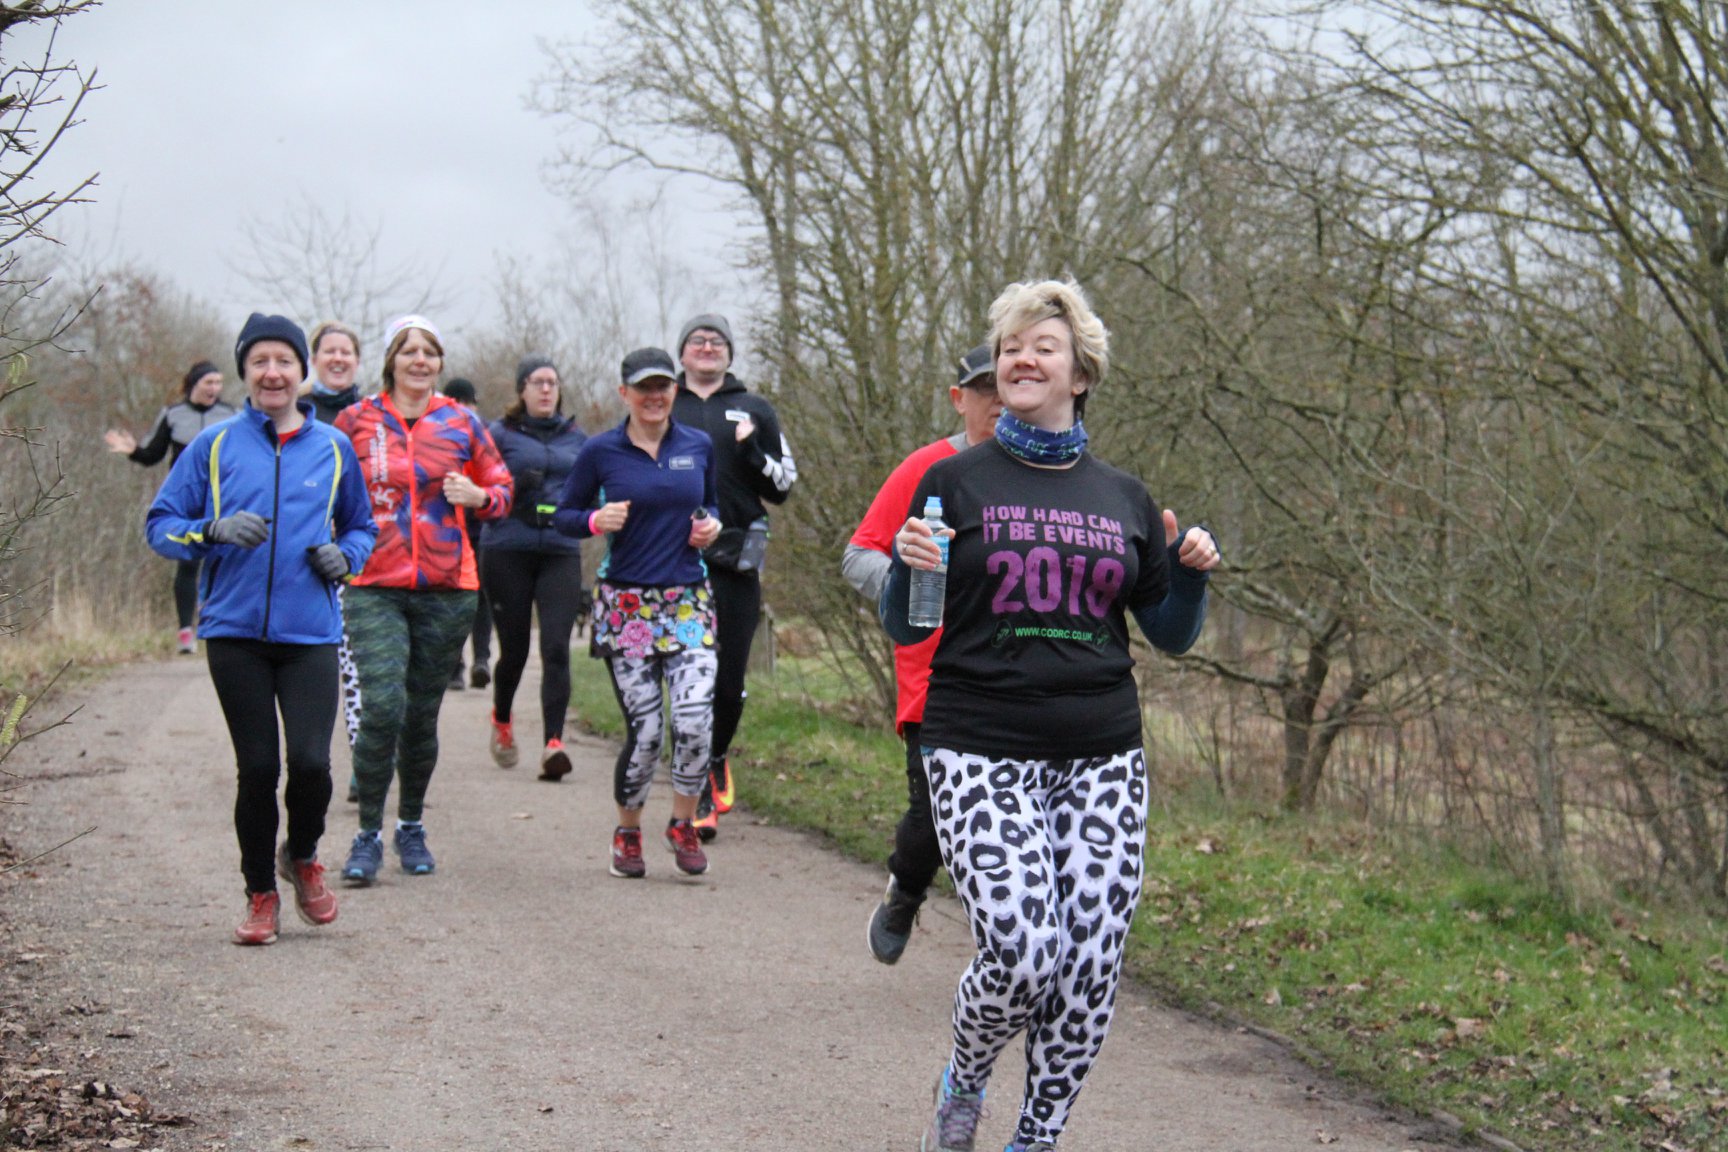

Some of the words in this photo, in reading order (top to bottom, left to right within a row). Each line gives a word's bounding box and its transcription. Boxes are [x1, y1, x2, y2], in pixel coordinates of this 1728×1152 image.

[982, 505, 1026, 521] HOW
[1033, 508, 1083, 526] HARD
[1087, 514, 1122, 535] CAN
[983, 523, 1002, 544] IT
[1009, 521, 1036, 541] BE
[1043, 524, 1125, 555] EVENTS
[986, 546, 1125, 618] 2018
[1014, 627, 1093, 641] WWW.CODRC.CO.UK
